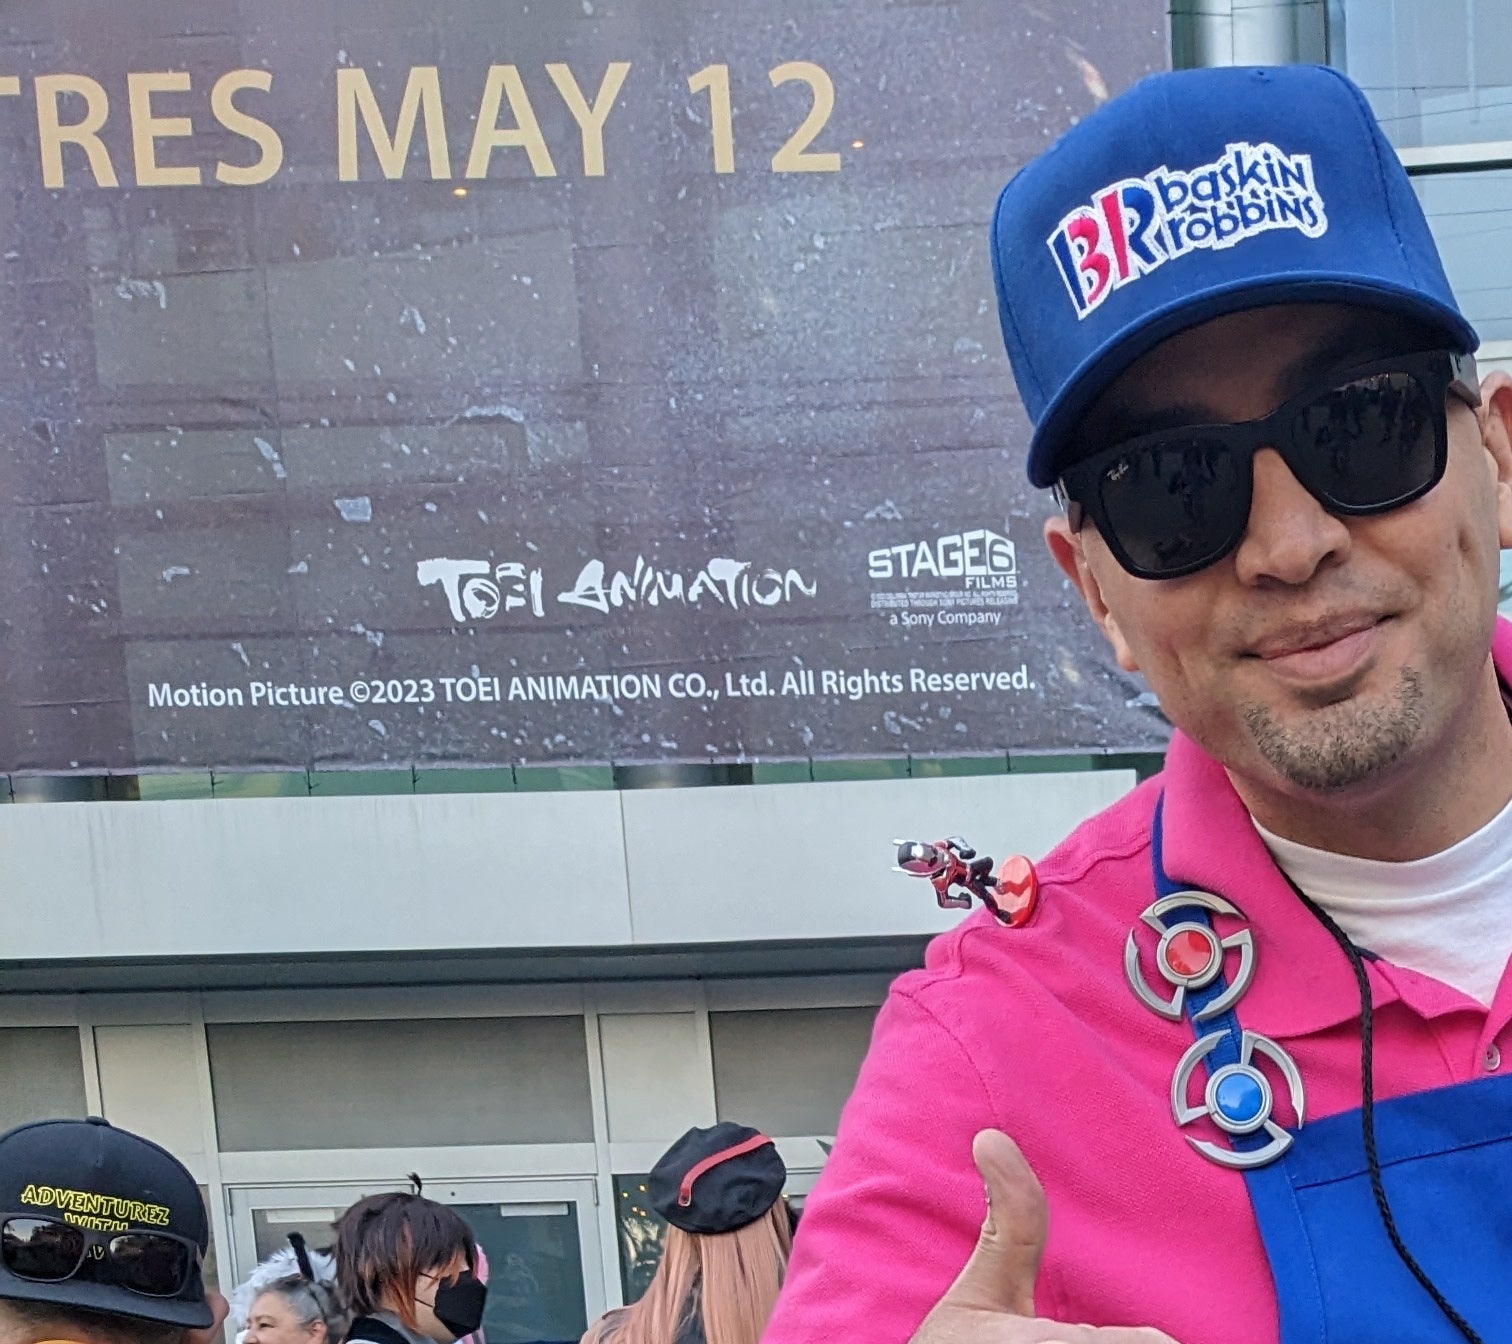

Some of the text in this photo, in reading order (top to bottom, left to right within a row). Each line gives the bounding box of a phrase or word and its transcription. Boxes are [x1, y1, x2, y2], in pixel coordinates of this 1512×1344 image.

[0, 61, 842, 189] RES MAY 12
[417, 557, 545, 623] TOEI
[965, 575, 1018, 589] FILMS
[889, 610, 1001, 627] a Sony Company
[148, 664, 1036, 708] Motion Picture ©2023 TOEI ANIMATION CO., Ltd. All Rights Reserved.
[21, 1185, 169, 1226] ADVENTUREZ
